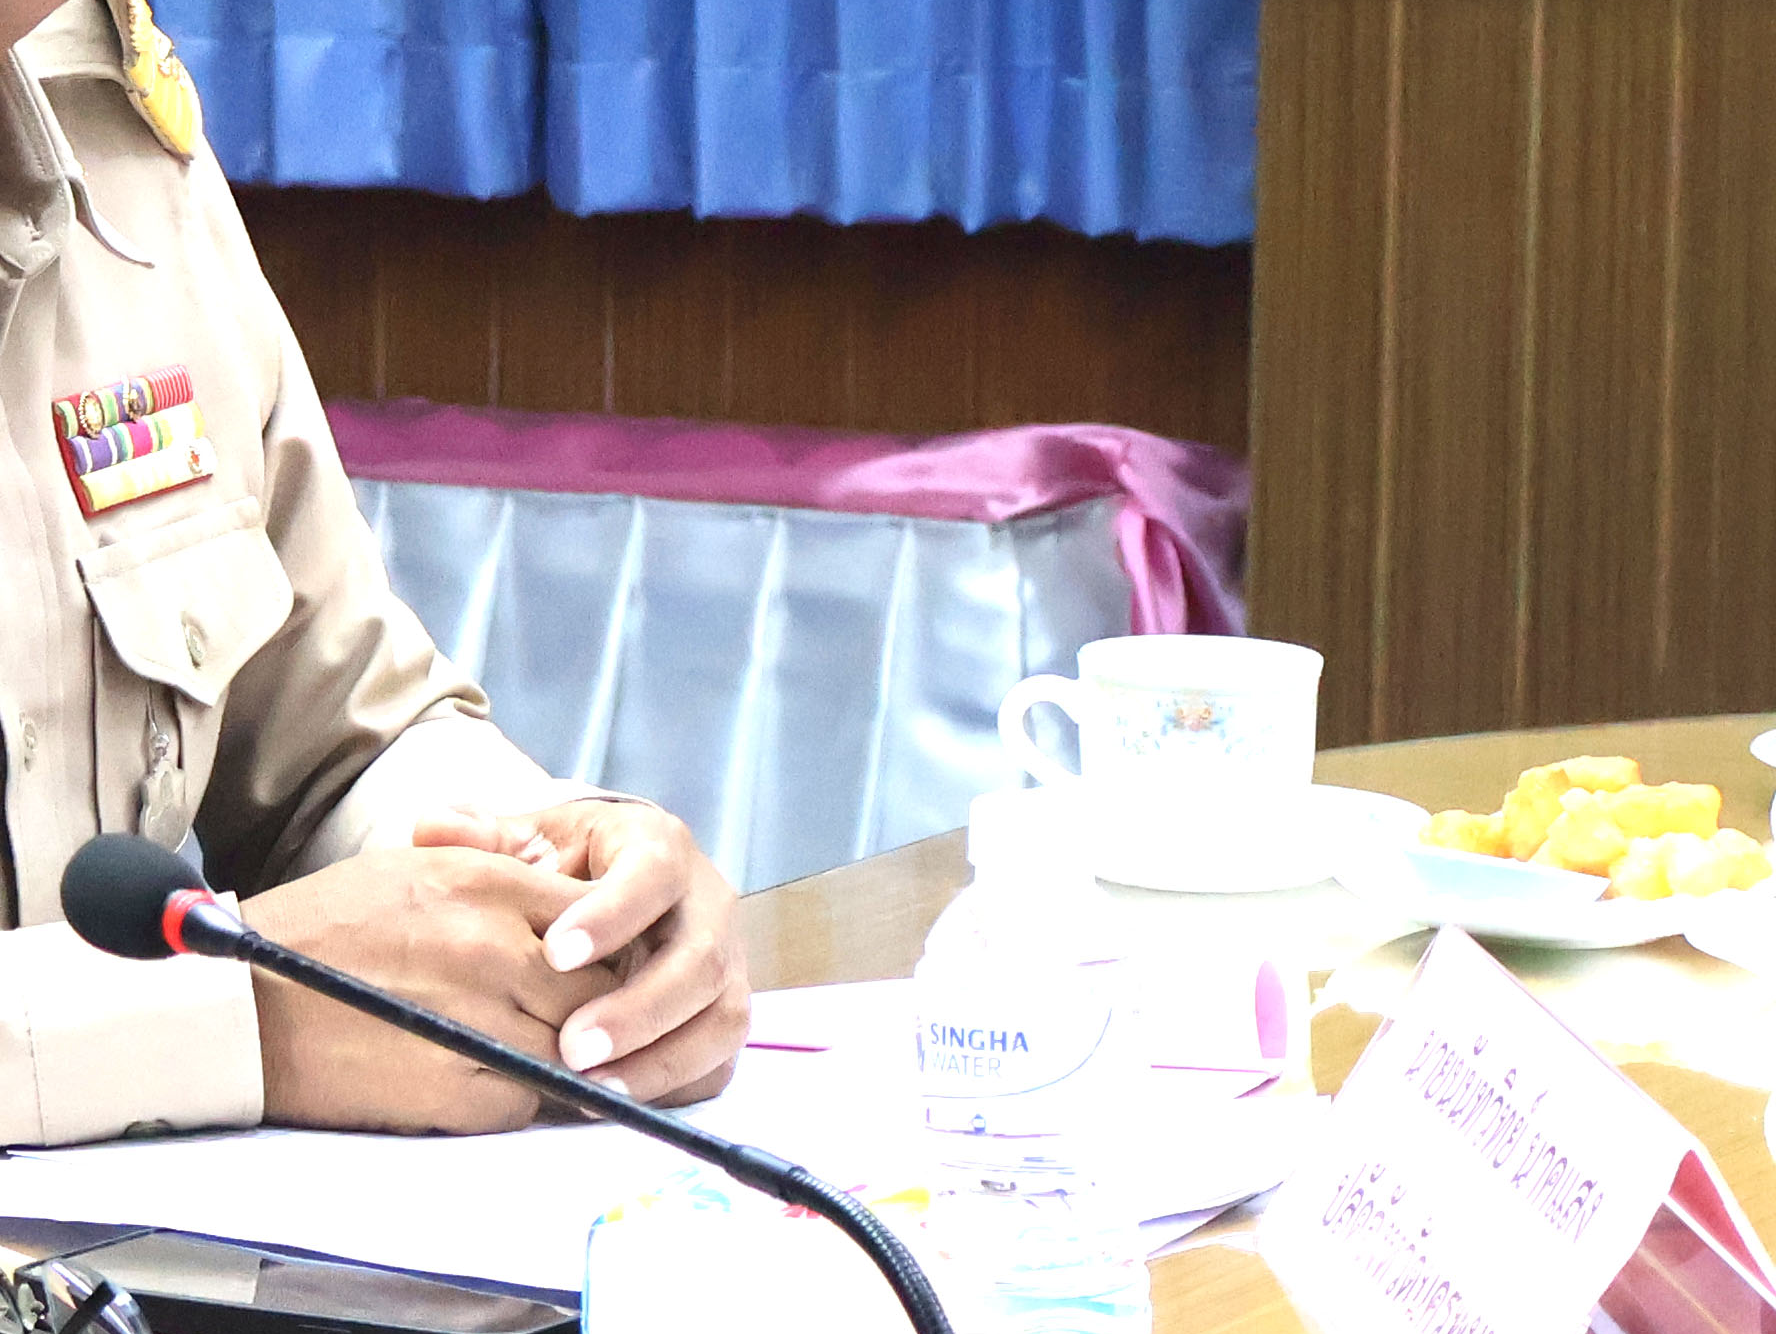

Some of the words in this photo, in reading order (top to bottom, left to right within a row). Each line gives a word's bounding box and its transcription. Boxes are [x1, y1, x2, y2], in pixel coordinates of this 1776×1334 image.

[930, 1022, 1030, 1054] SINGHA
[931, 1050, 1002, 1078] WATER
[1510, 1131, 1604, 1244] นาคแสง
